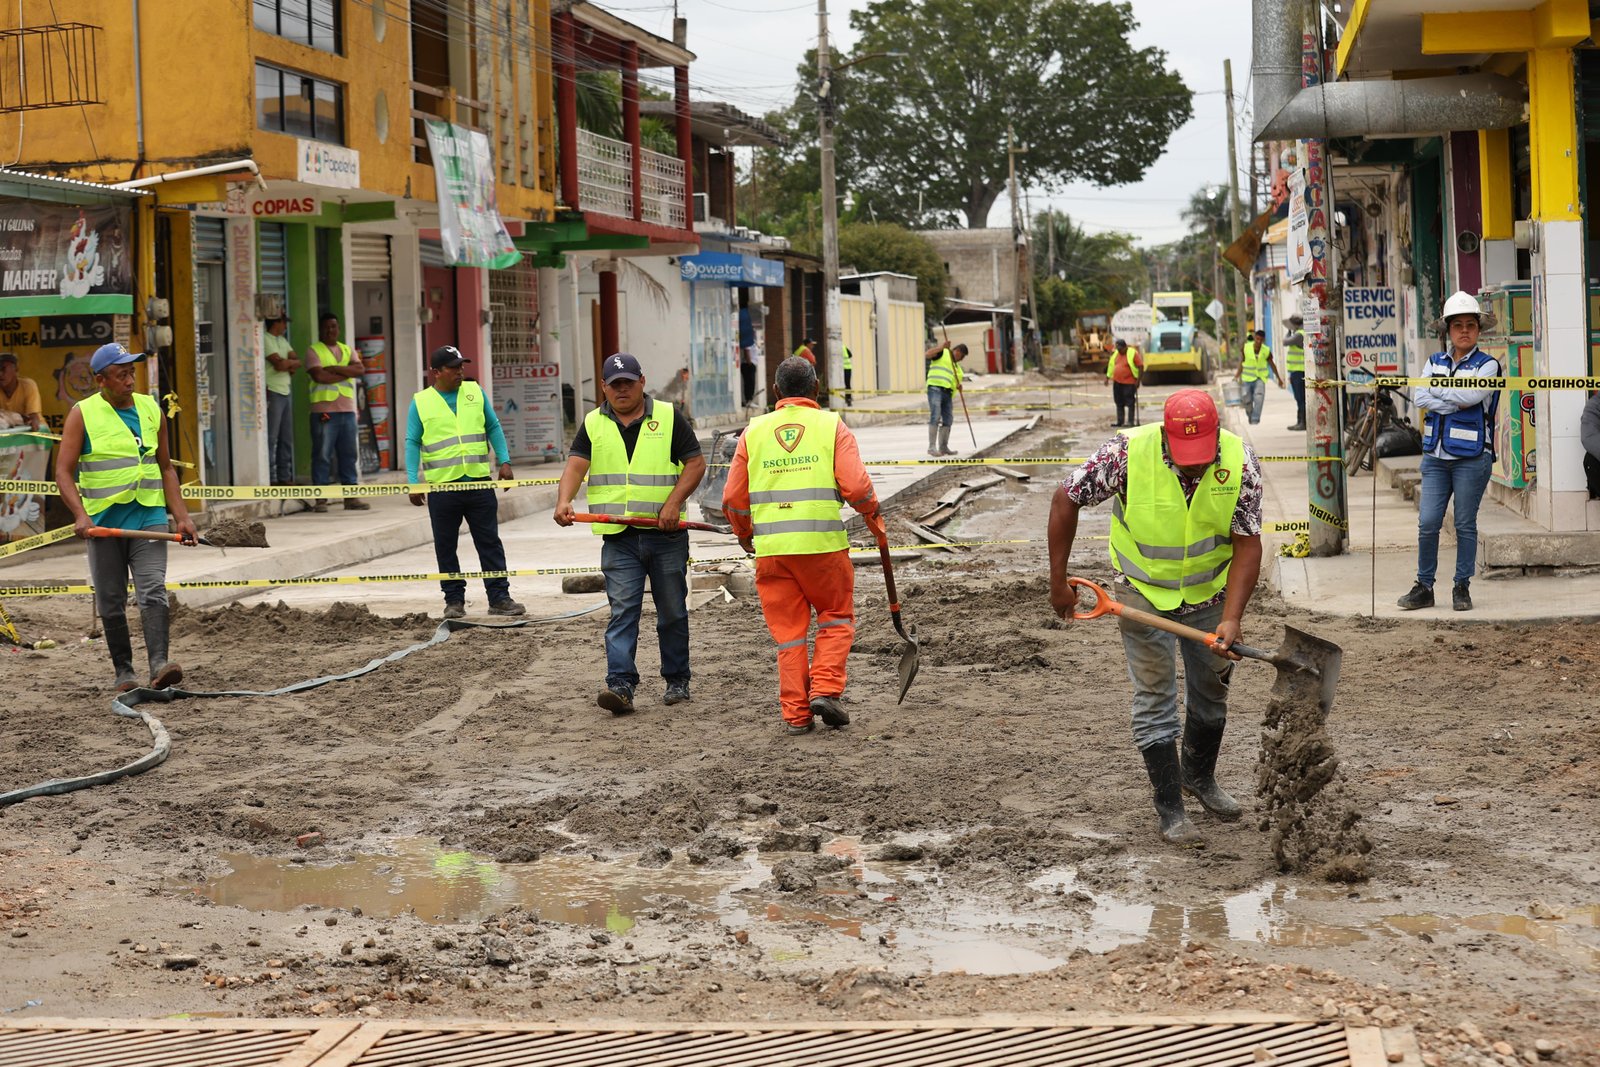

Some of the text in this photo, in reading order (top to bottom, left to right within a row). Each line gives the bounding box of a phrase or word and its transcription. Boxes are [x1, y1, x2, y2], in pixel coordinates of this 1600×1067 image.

[252, 198, 314, 215] COPIAS
[3, 270, 57, 291] MARIFER
[41, 321, 112, 340] HALO
[2, 332, 38, 347] LINEA
[493, 365, 557, 379] BIERTO
[1430, 378, 1506, 388] PROHIBIDO
[784, 429, 796, 441] E
[763, 455, 819, 468] ESCUDERO
[769, 466, 812, 474] CONSTRUCCIONES
